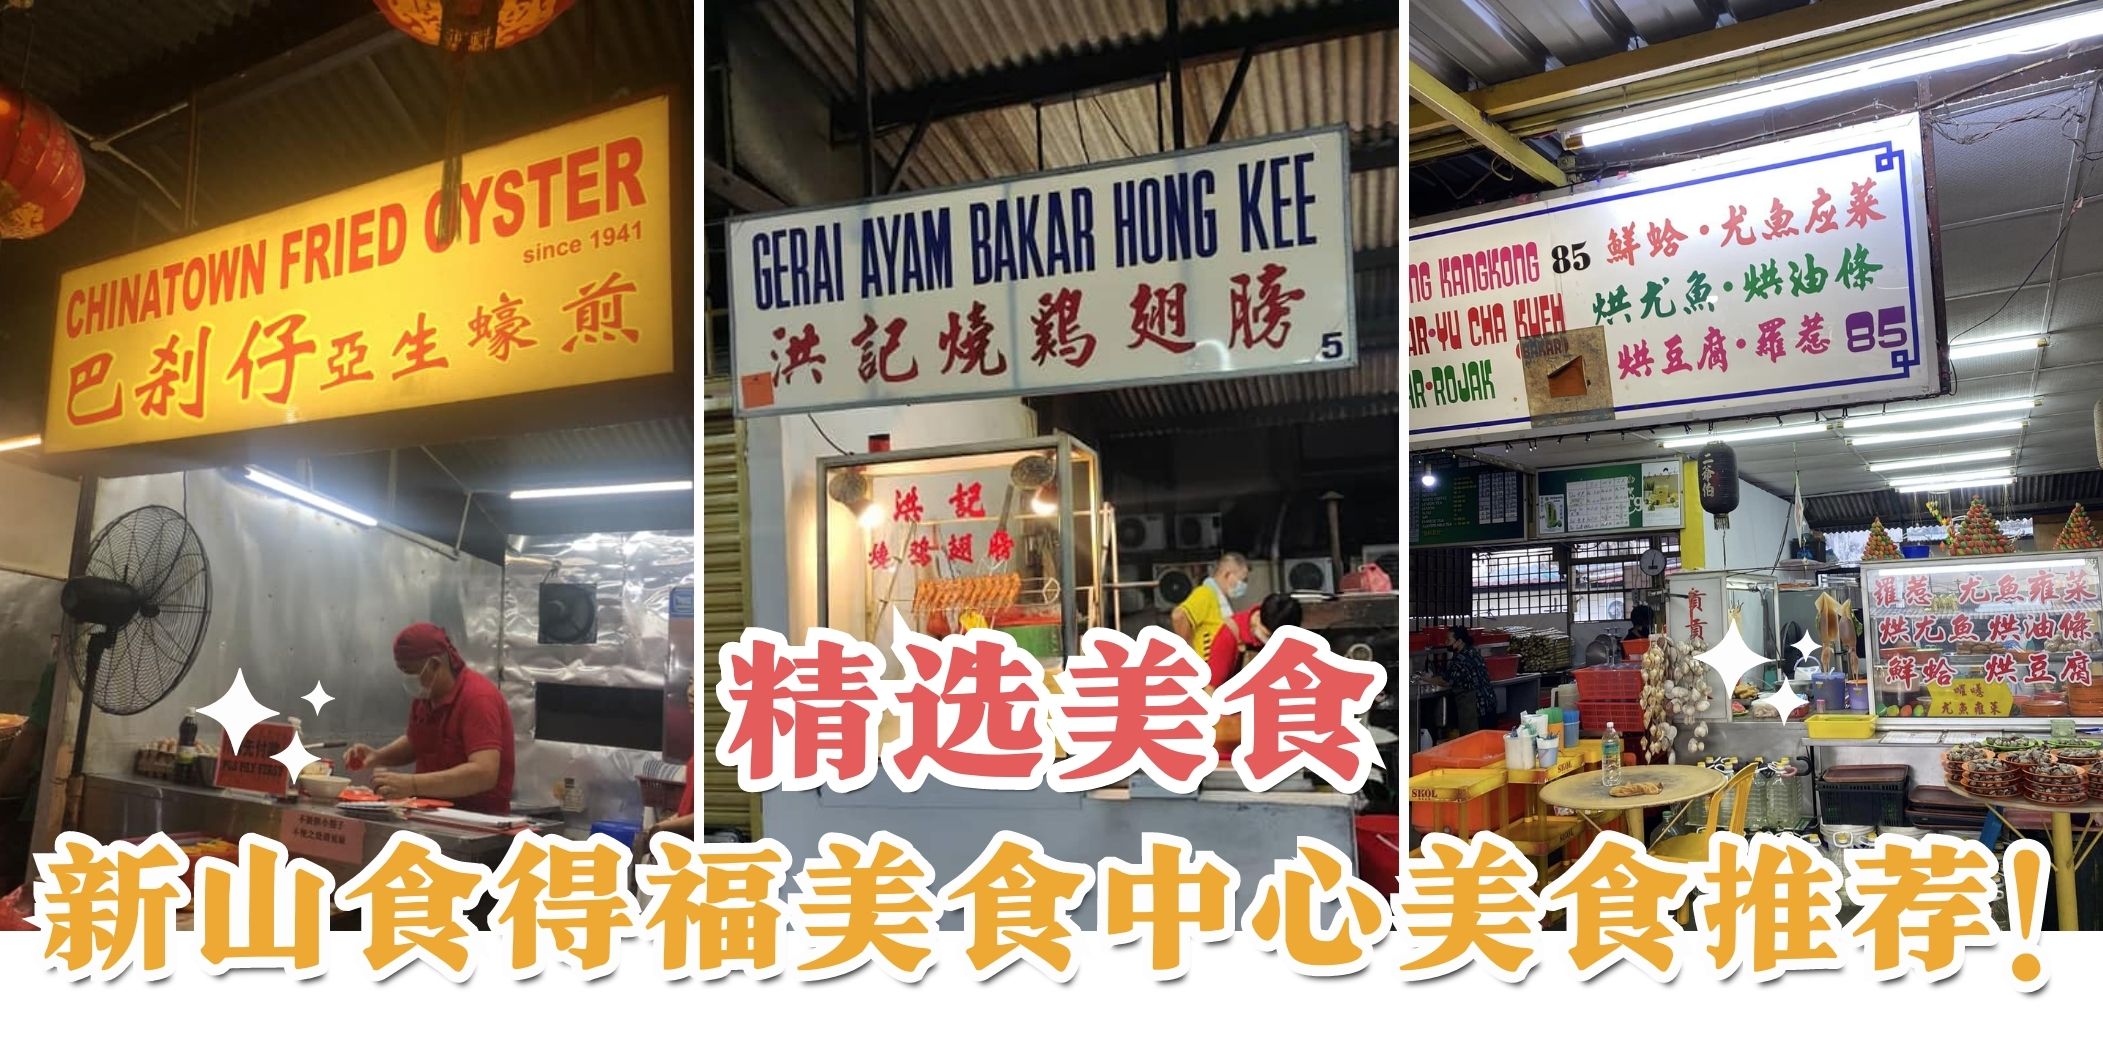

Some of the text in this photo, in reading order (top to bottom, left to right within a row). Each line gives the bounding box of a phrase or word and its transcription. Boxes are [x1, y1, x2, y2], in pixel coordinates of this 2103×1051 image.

[65, 136, 647, 338] CHINATOWN FRIED OYSTER
[523, 220, 642, 264] since 1941
[752, 152, 1318, 311] GERAI AYAM BAKAR HONG KEE
[1438, 241, 1541, 299] KANGKONG
[1551, 240, 1592, 274] 85
[1322, 332, 1344, 358] 5
[1467, 302, 1508, 347] CHA
[1845, 305, 1908, 353] 85
[893, 481, 987, 523] 洪記
[1557, 760, 1573, 773] SKOL
[1411, 788, 1438, 798] SKOL
